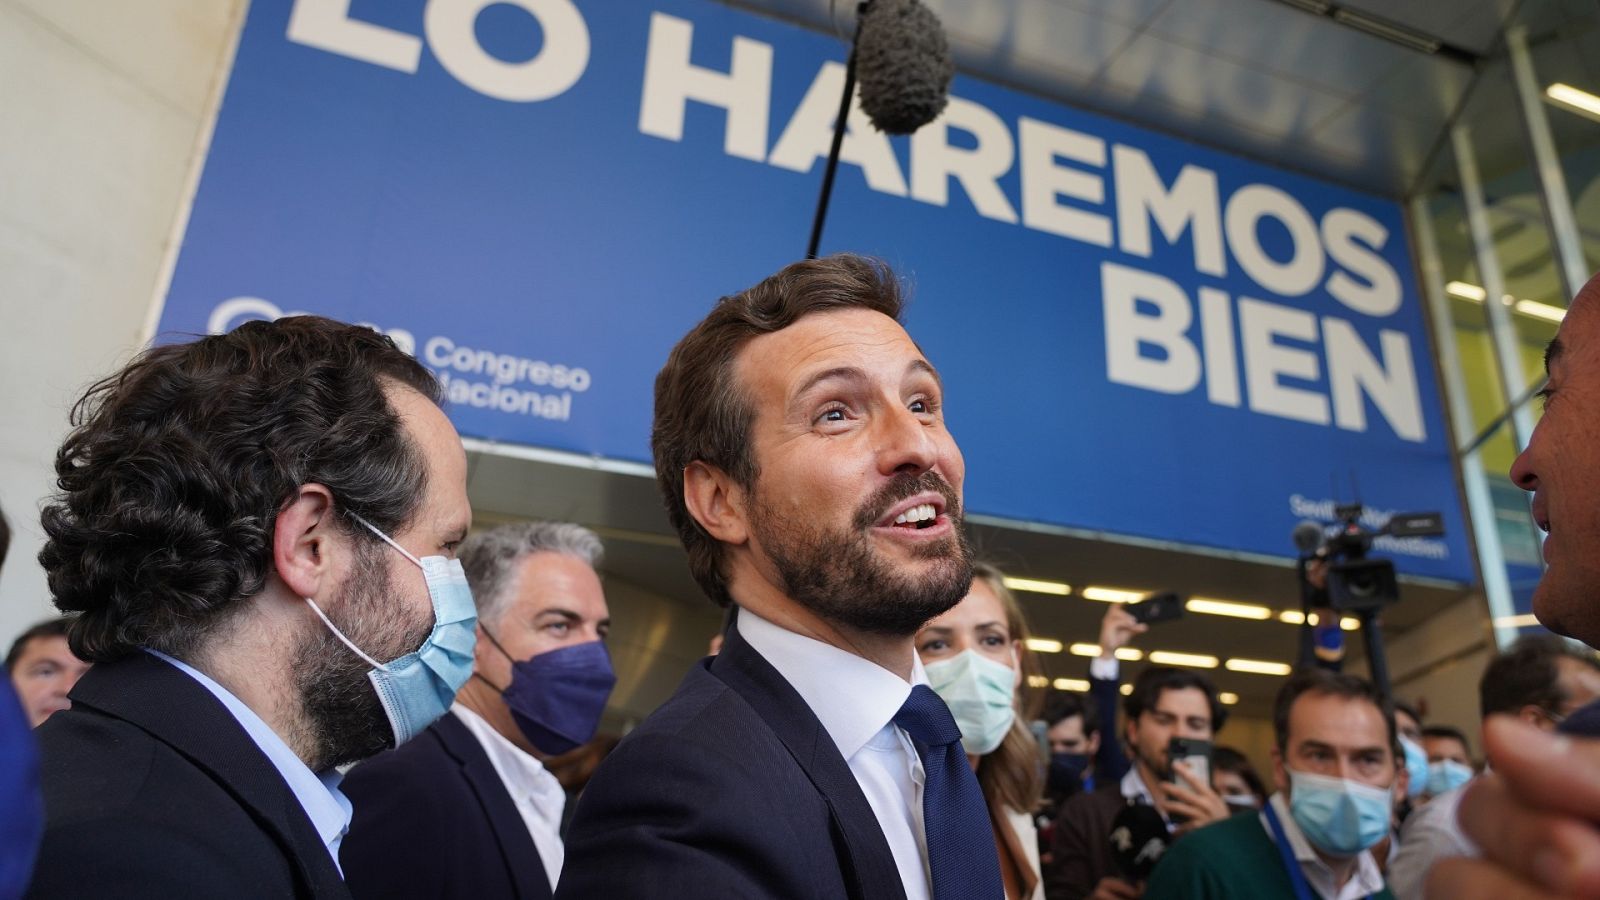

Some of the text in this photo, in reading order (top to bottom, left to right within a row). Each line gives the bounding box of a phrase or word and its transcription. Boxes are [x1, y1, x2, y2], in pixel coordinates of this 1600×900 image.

[638, 12, 1403, 315] HAREMOS
[424, 336, 591, 392] Congreso
[1101, 262, 1425, 442] BIEN
